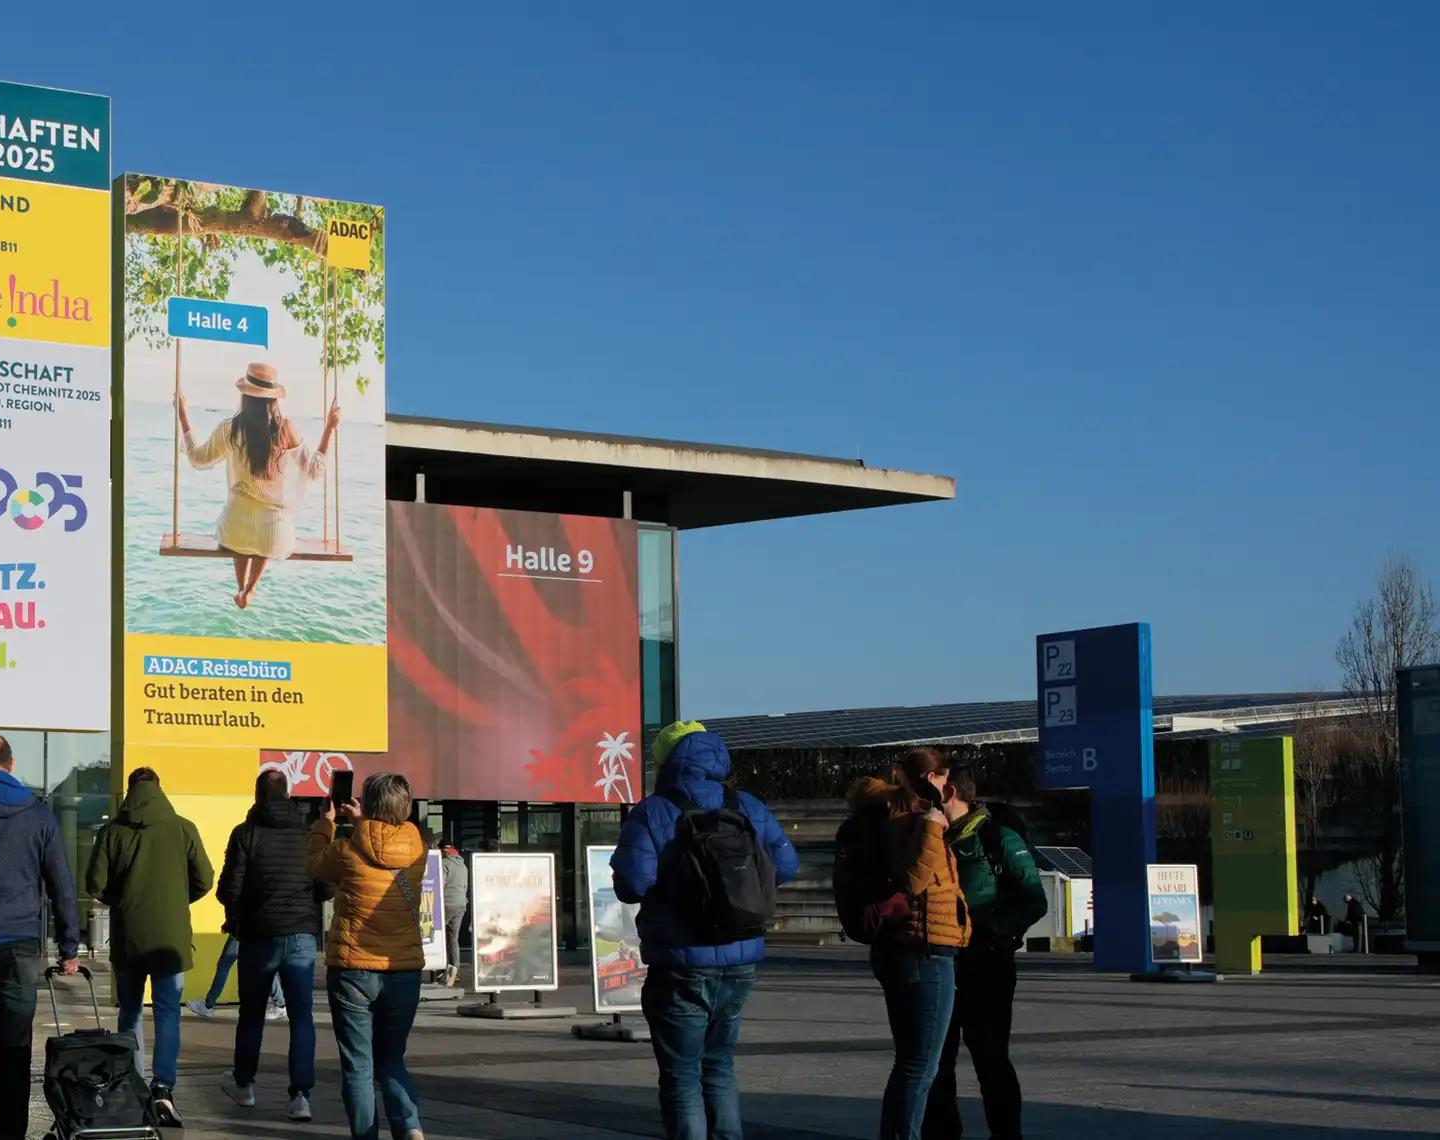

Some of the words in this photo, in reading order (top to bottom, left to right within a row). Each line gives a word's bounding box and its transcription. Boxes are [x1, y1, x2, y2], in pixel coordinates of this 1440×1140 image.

[329, 221, 369, 240] ADAC
[188, 311, 232, 331] Halle
[237, 317, 249, 332] 4
[13, 383, 74, 399] CHEMNITZ
[75, 389, 101, 402] 2025
[6, 399, 55, 412] REGION.
[506, 544, 571, 572] Halle
[578, 549, 594, 574] 9
[148, 658, 198, 675] ADAC
[202, 660, 288, 679] Reisebüro
[1046, 645, 1059, 671] P
[1057, 662, 1072, 677] 22
[144, 683, 175, 699] Gut
[179, 683, 247, 702] beraten
[250, 686, 268, 702] in
[272, 687, 304, 704] den
[1047, 691, 1061, 716] P
[144, 709, 266, 728] Traumurlaub.
[1045, 748, 1076, 760] Bereich
[1082, 747, 1098, 771] B
[1045, 763, 1073, 773] Sector
